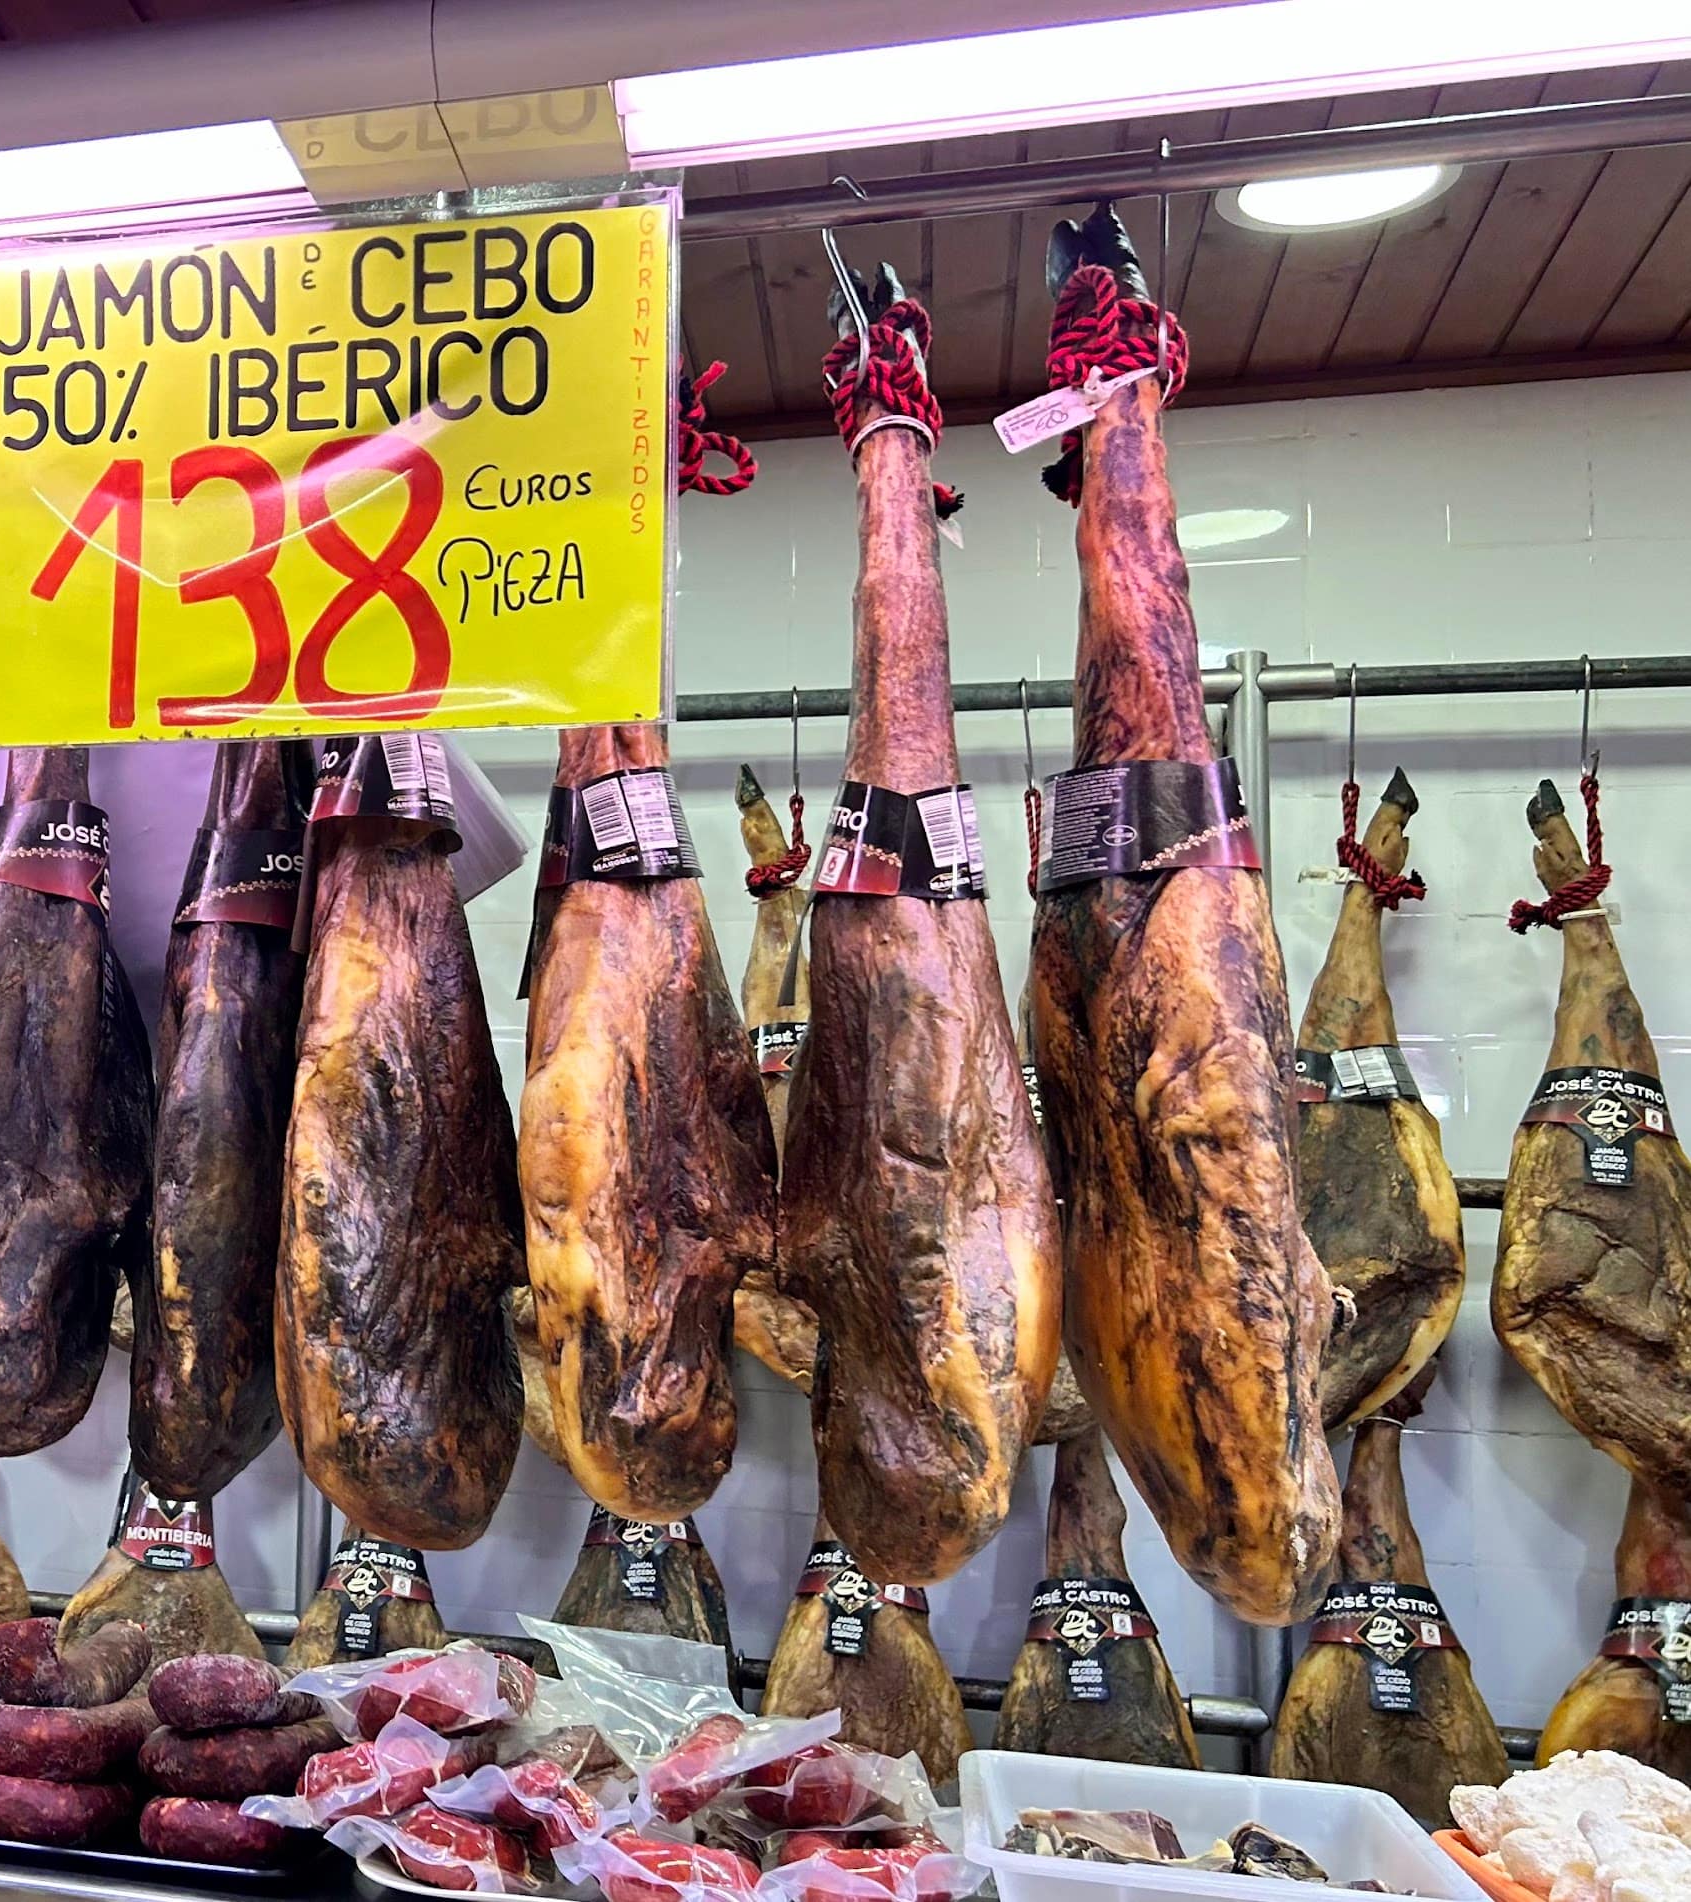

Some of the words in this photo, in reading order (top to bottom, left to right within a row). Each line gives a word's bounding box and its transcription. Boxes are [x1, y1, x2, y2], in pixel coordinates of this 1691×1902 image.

[351, 221, 595, 328] CEBO
[629, 210, 657, 534] GARANTIZADOS
[3, 360, 148, 451] 50%
[209, 326, 549, 440] IBÉRICO
[465, 464, 593, 511] EUROS
[30, 433, 452, 728] 138
[829, 806, 869, 831] TRO
[40, 822, 101, 846] JOSÉ
[260, 853, 305, 873] JOS
[1597, 1069, 1624, 1079] DON
[1545, 1076, 1593, 1094] JOSÉ
[1597, 1080, 1664, 1104] CASTRO
[126, 1526, 212, 1548] MONTIBERIA
[334, 1548, 357, 1562] OSÉ
[358, 1550, 416, 1571] CASTRO
[808, 1549, 843, 1565] JOSÉ
[1063, 1580, 1087, 1589] DON
[1370, 1585, 1396, 1595] DON
[1065, 1590, 1130, 1606] CASTRO
[1324, 1593, 1368, 1610] JOSÉ
[1371, 1595, 1438, 1615] CASTRO
